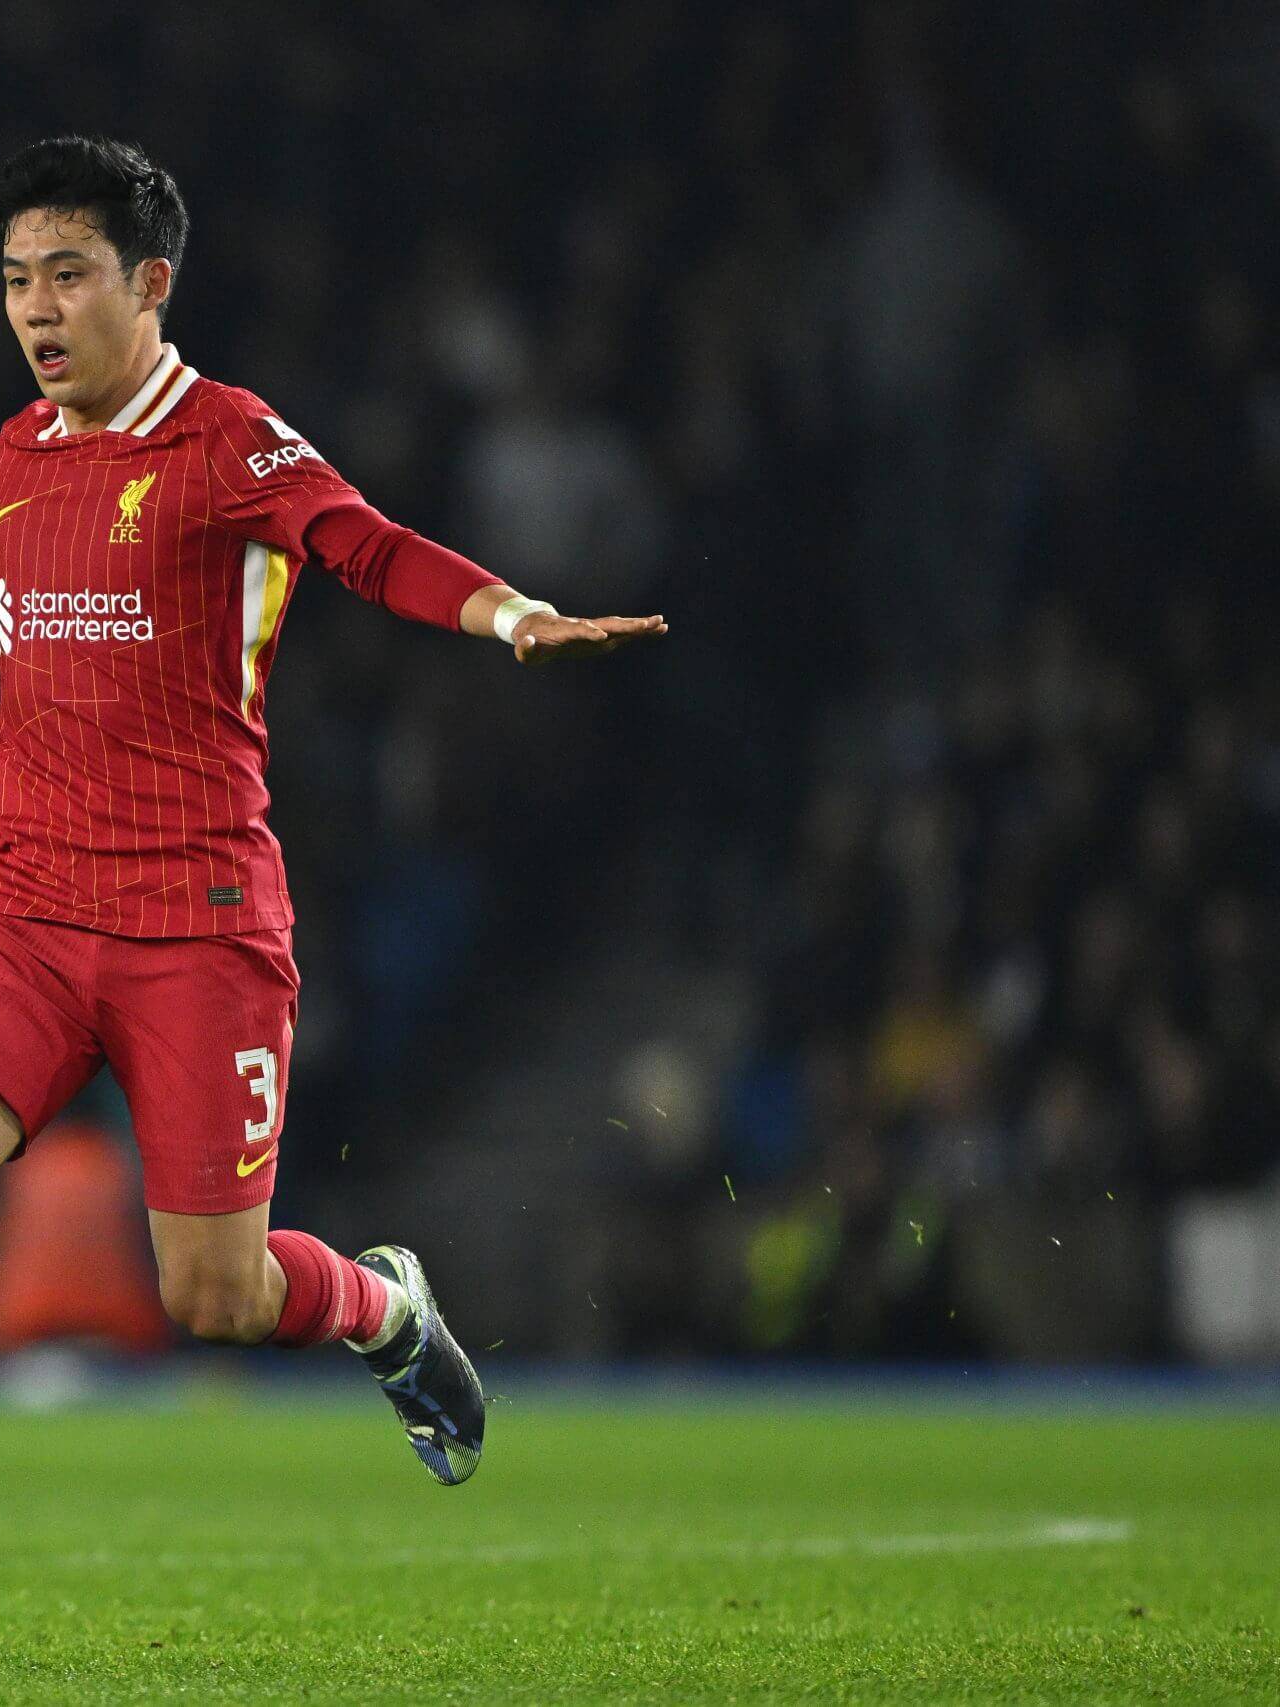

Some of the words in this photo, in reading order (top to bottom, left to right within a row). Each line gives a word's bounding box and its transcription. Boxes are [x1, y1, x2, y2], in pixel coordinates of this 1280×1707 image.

[246, 443, 323, 479] Expe
[21, 587, 142, 615] standard
[19, 615, 154, 641] chartered
[234, 1046, 278, 1144] 3
